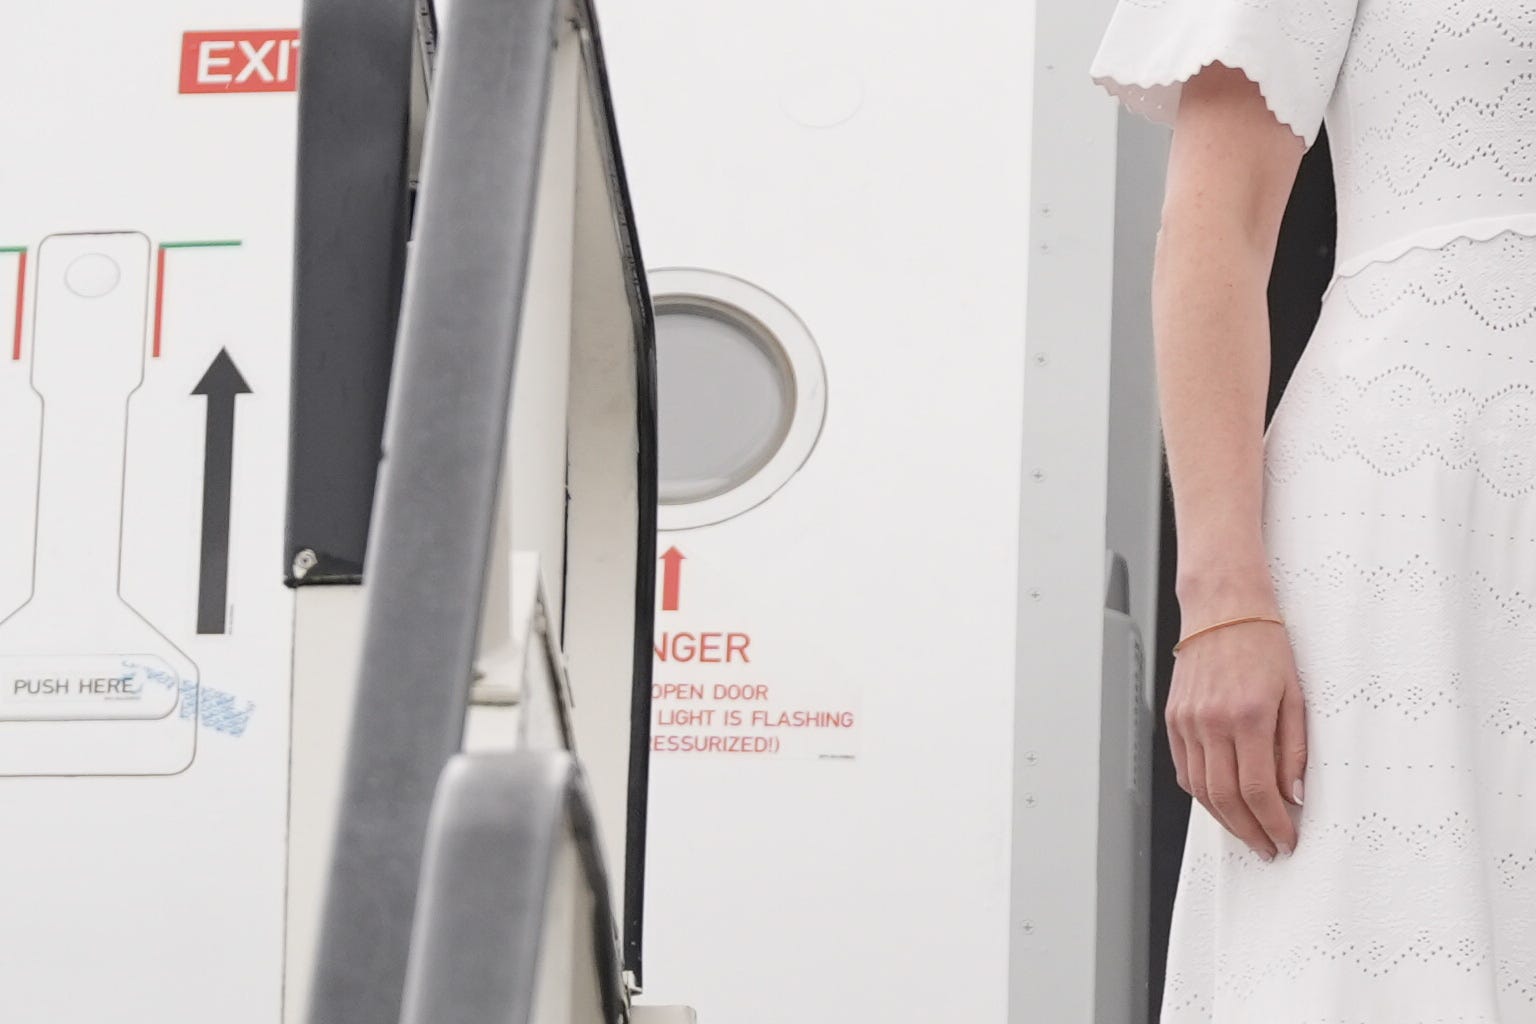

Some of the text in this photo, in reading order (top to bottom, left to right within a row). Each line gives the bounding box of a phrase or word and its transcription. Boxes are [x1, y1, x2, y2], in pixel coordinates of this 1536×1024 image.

[654, 631, 751, 663] NGER
[13, 677, 134, 695] PUSH HERE
[652, 683, 769, 701] OPEN DOOR
[658, 709, 854, 728] LIGHT IS FLASHING
[649, 735, 780, 754] ESSURIZED!)
